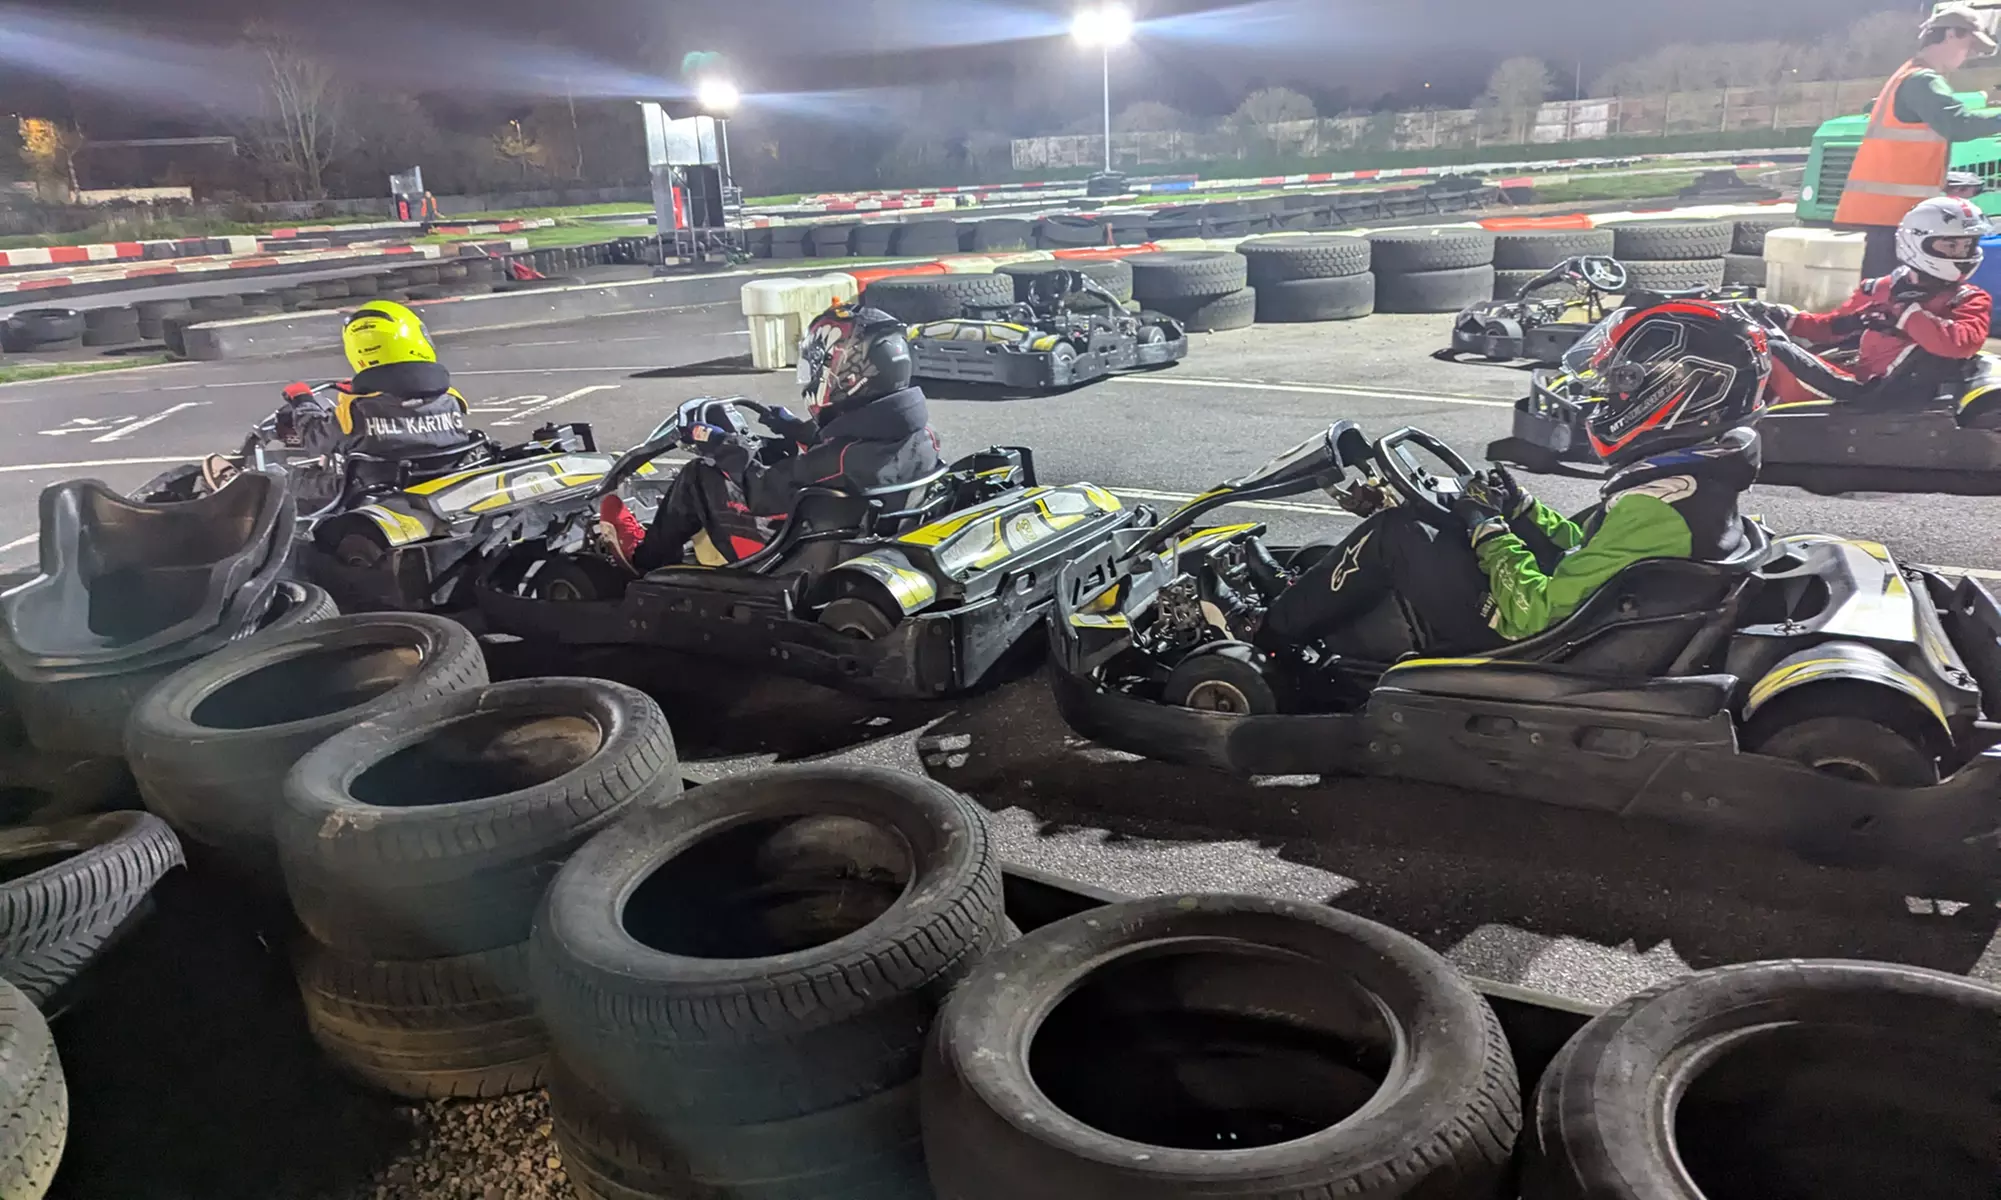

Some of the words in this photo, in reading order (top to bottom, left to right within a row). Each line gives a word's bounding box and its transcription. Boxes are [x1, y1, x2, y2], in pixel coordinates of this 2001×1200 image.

[366, 416, 403, 436] HULL
[406, 411, 463, 434] KARTING
[1609, 417, 1625, 433] MT
